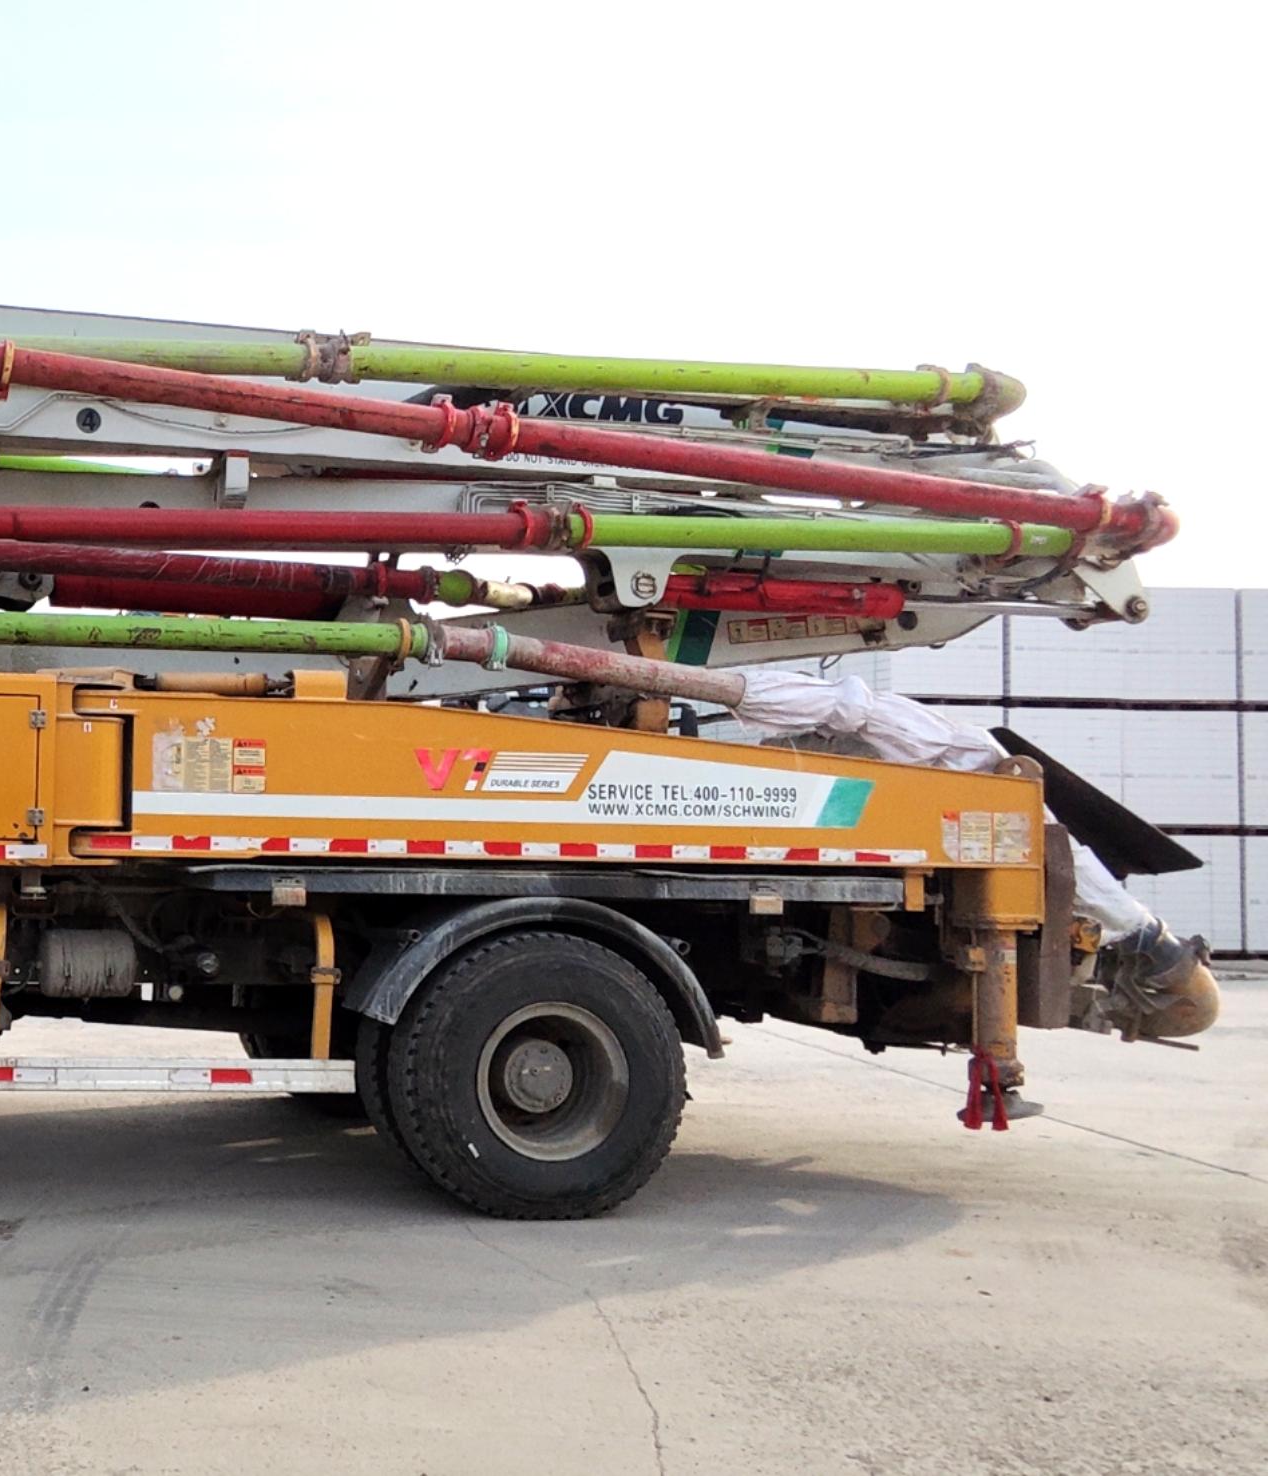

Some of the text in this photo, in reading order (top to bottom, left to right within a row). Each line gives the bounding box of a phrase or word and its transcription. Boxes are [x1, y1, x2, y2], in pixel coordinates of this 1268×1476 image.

[538, 393, 683, 424] XCMG
[490, 779, 560, 788] DURABLE SERIES
[587, 784, 653, 801] SERVICE
